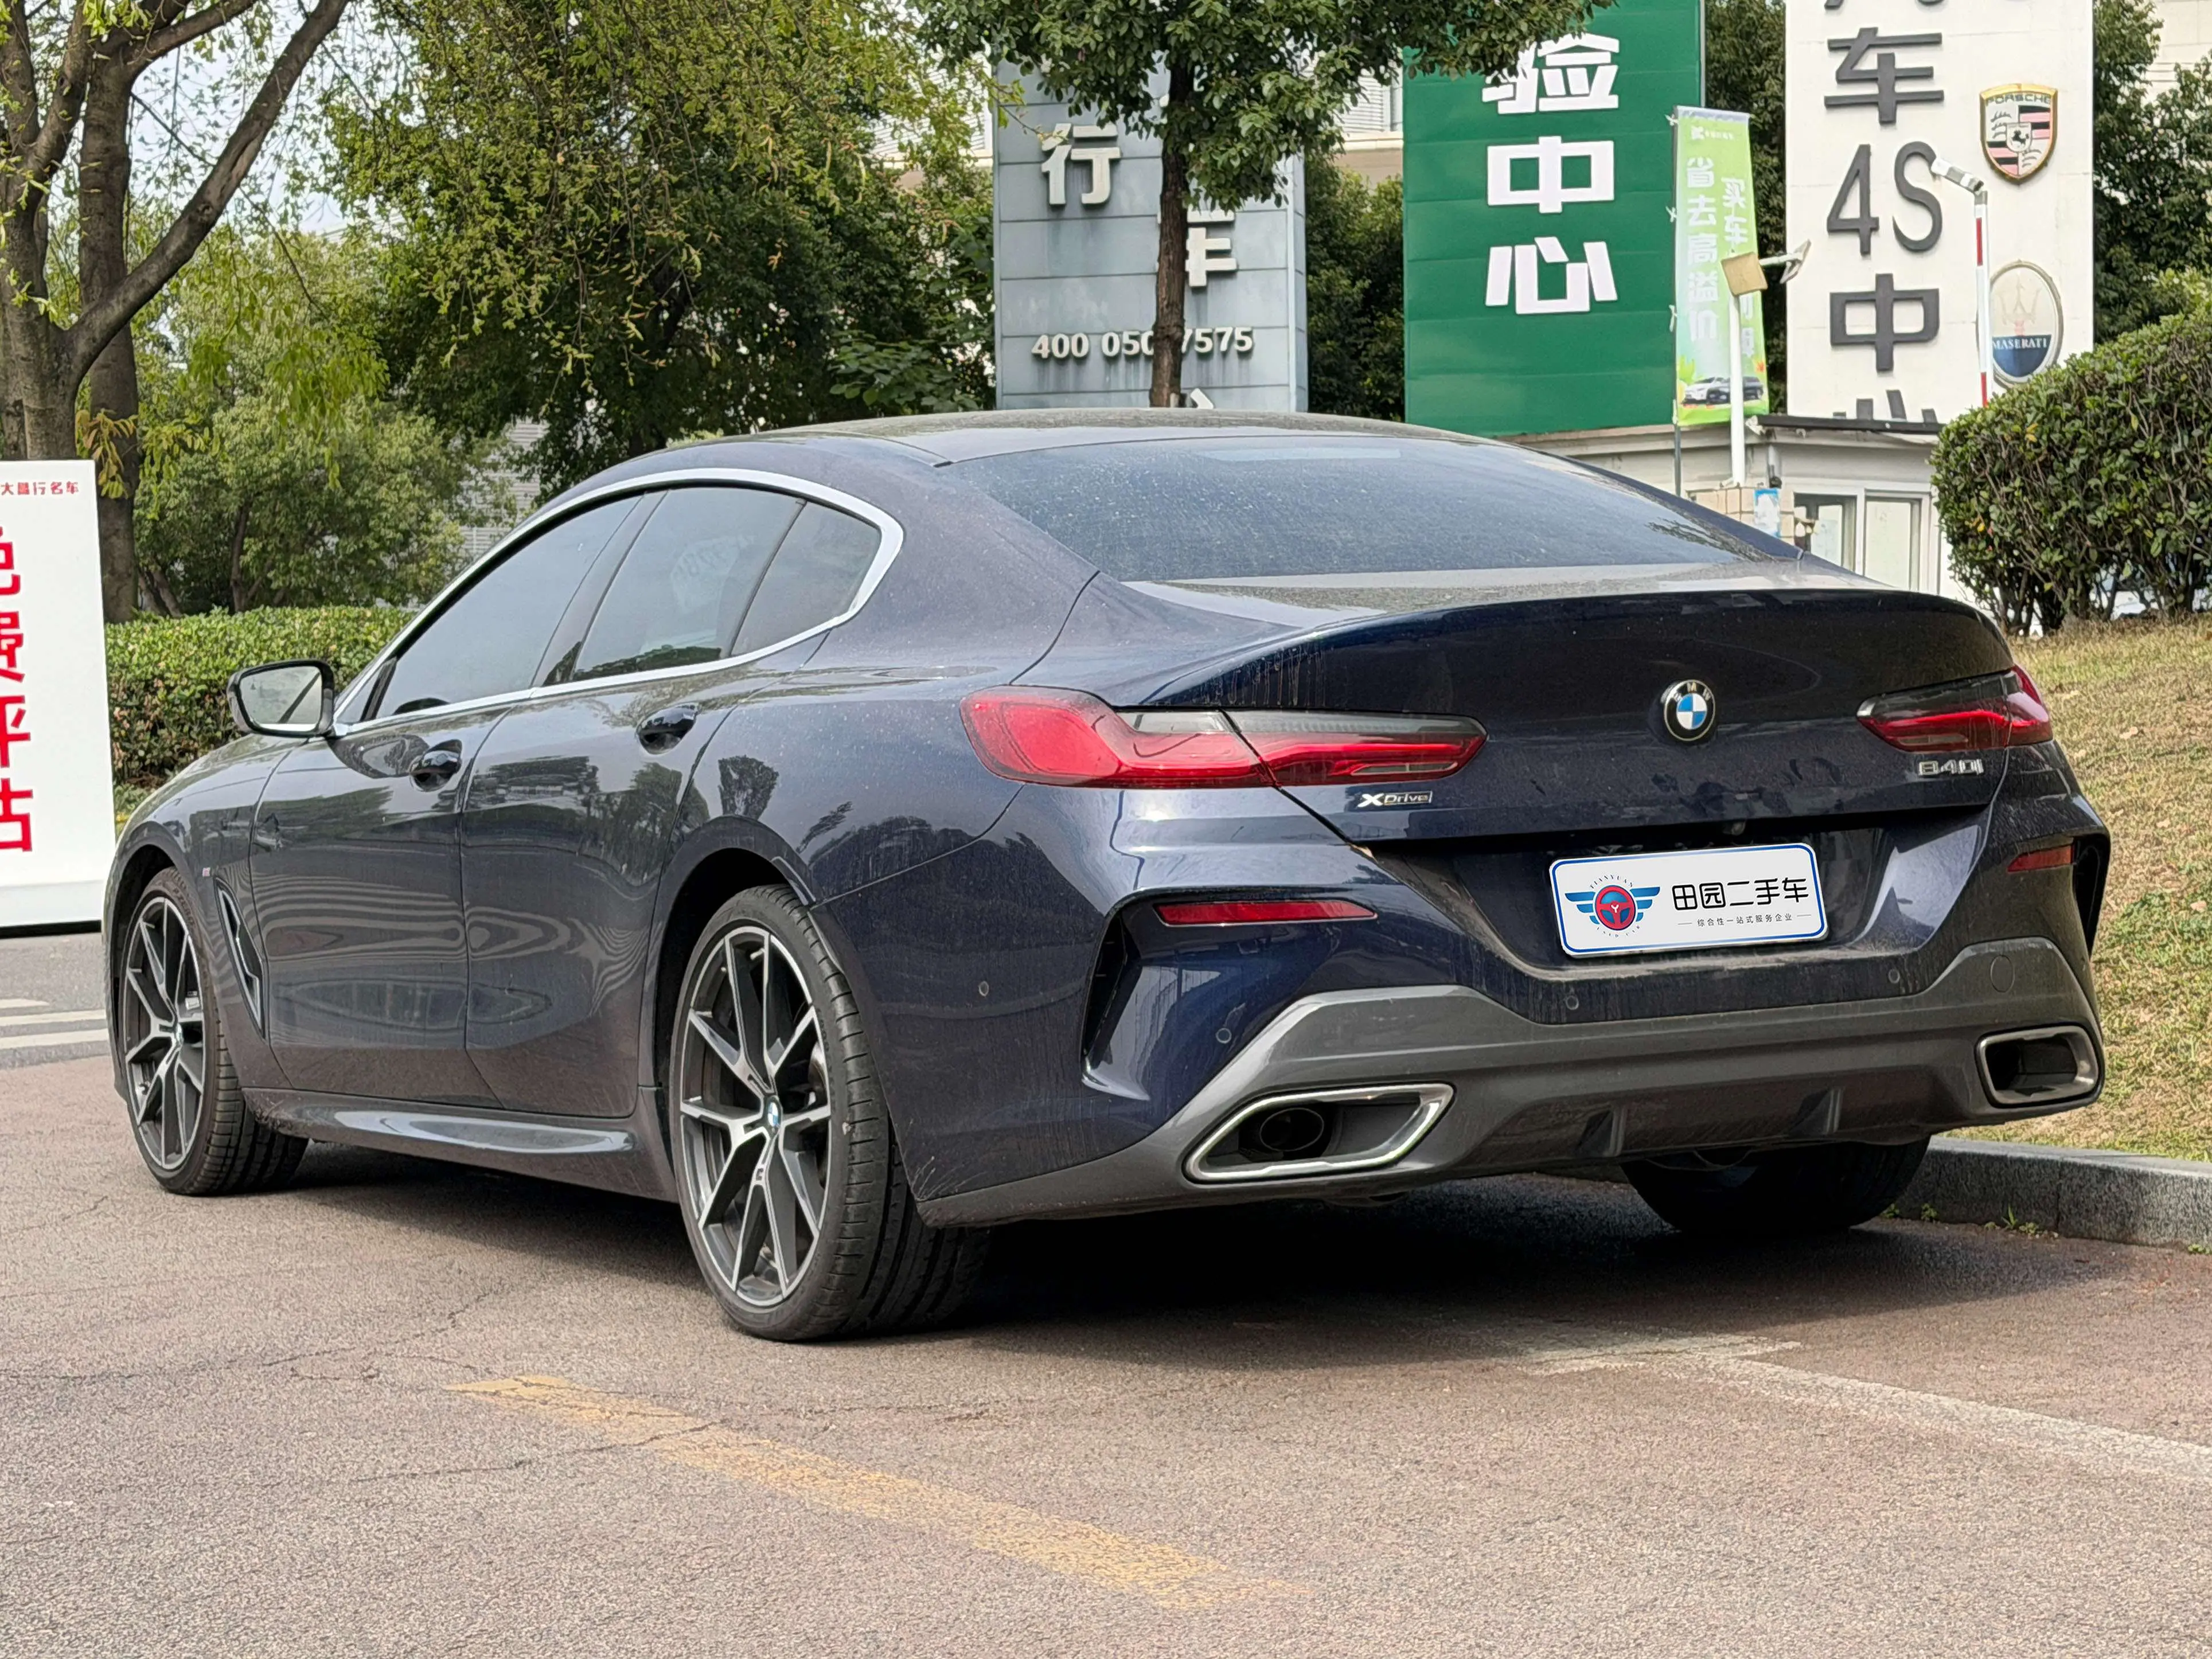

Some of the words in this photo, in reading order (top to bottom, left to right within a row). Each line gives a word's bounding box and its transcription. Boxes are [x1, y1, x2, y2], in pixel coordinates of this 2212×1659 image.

[1984, 92, 2051, 106] PORSCHE
[1041, 123, 1121, 206] 行
[1483, 33, 1619, 315] 验中心
[1032, 333, 1089, 359] 400
[1992, 337, 2047, 350] MASERATI
[1672, 877, 1809, 911] 田园二手车
[1697, 913, 1793, 927] 综合性一站式服务企业
